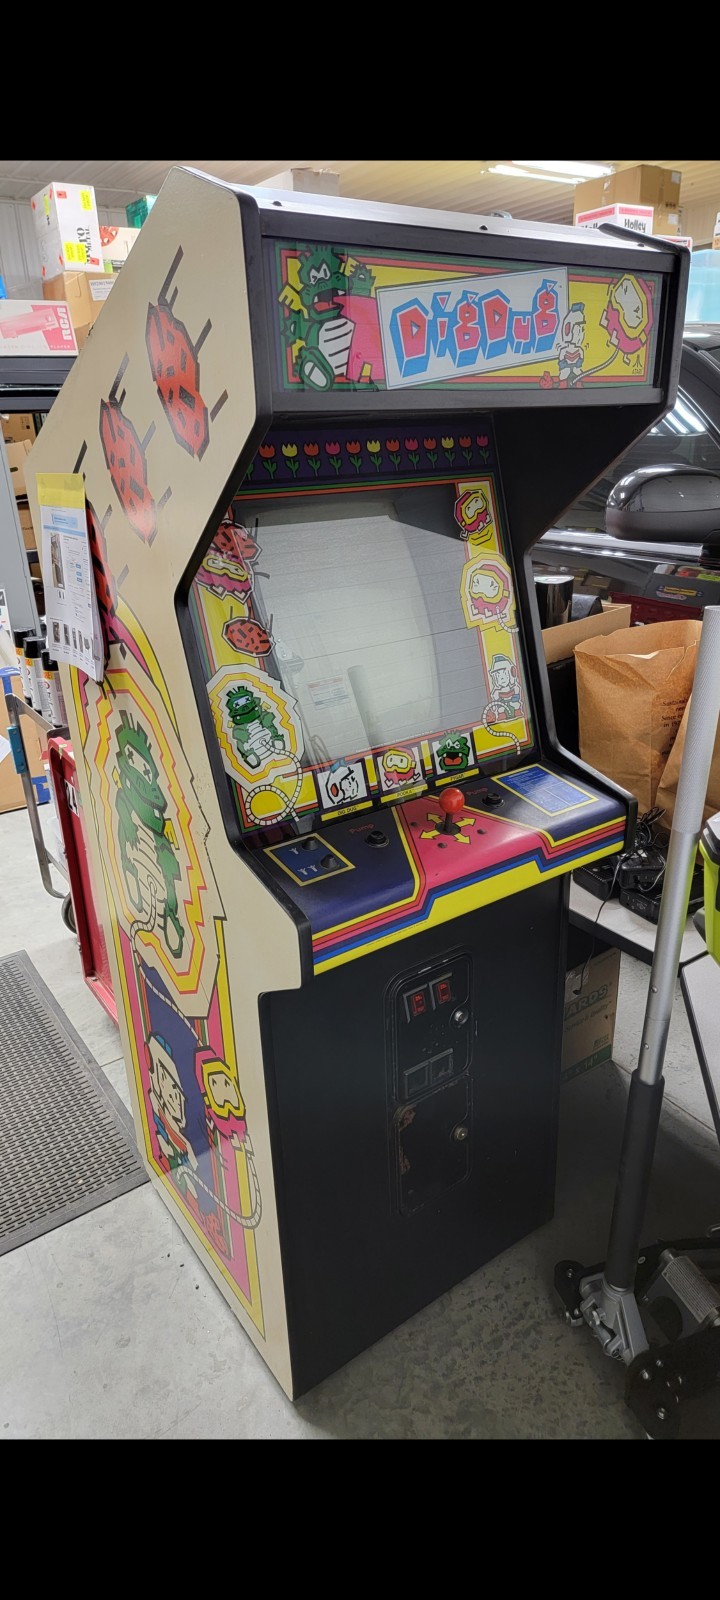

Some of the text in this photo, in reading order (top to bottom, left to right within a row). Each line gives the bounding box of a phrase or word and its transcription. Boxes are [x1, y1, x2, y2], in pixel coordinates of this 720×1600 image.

[624, 218, 647, 233] Holley
[57, 307, 72, 341] RCA
[337, 805, 358, 816] DIG DUG
[349, 822, 375, 835] Pump
